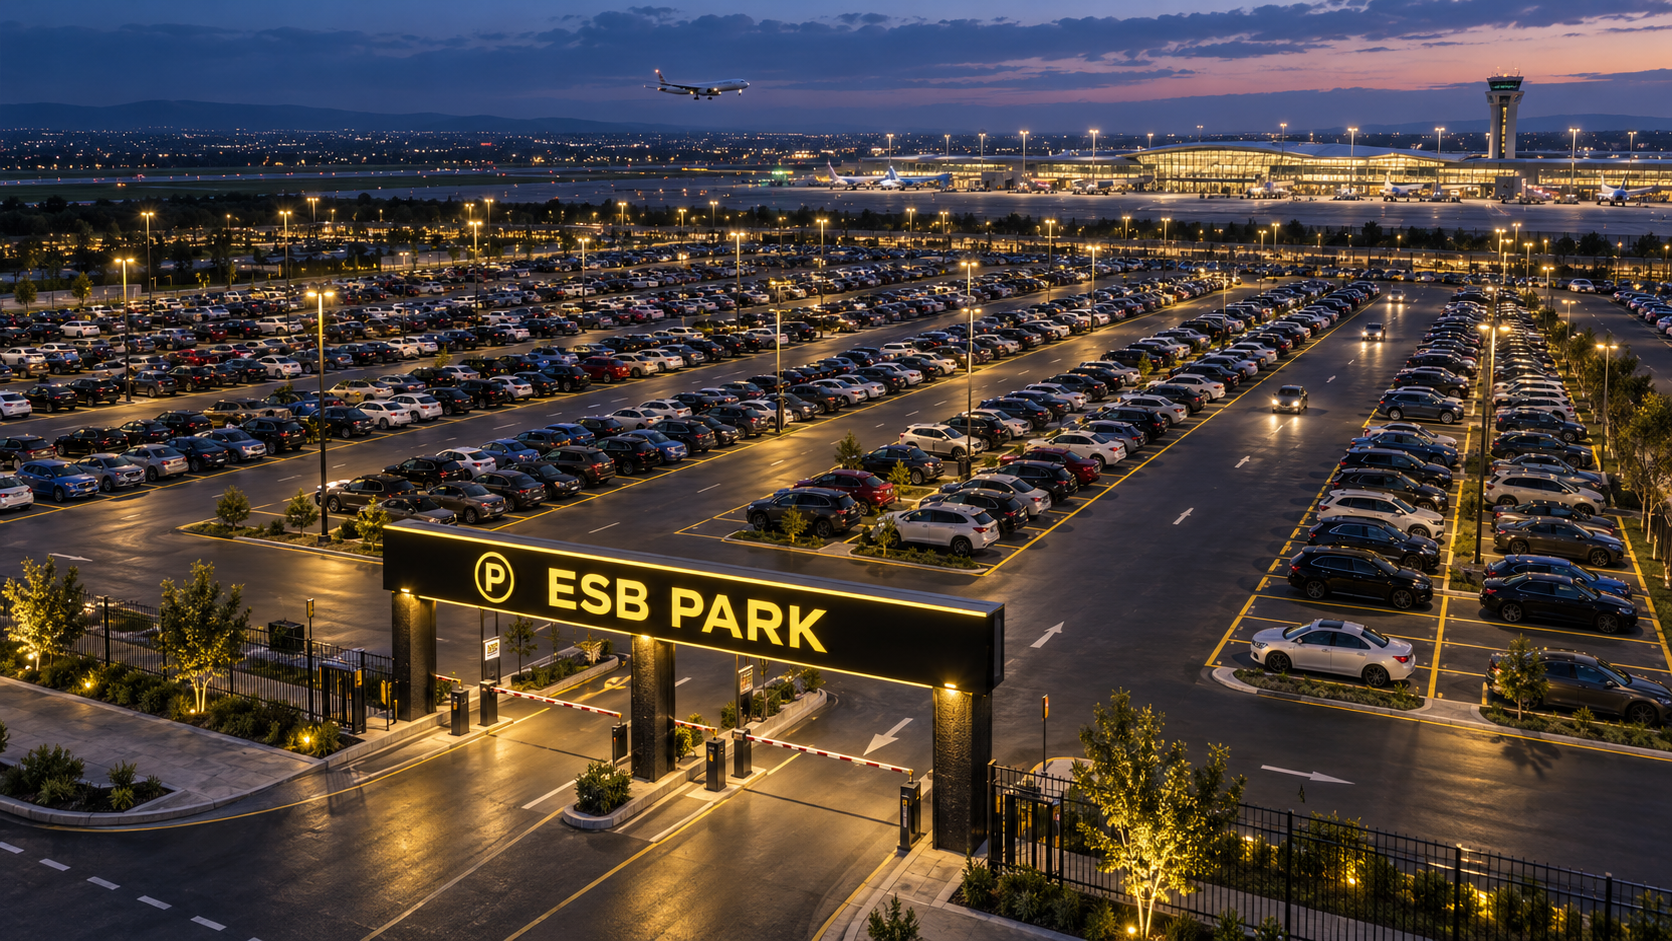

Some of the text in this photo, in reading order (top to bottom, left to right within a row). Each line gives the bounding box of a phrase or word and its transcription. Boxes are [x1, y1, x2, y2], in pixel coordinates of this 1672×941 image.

[485, 563, 506, 591] P
[548, 567, 828, 654] ESB PARK
